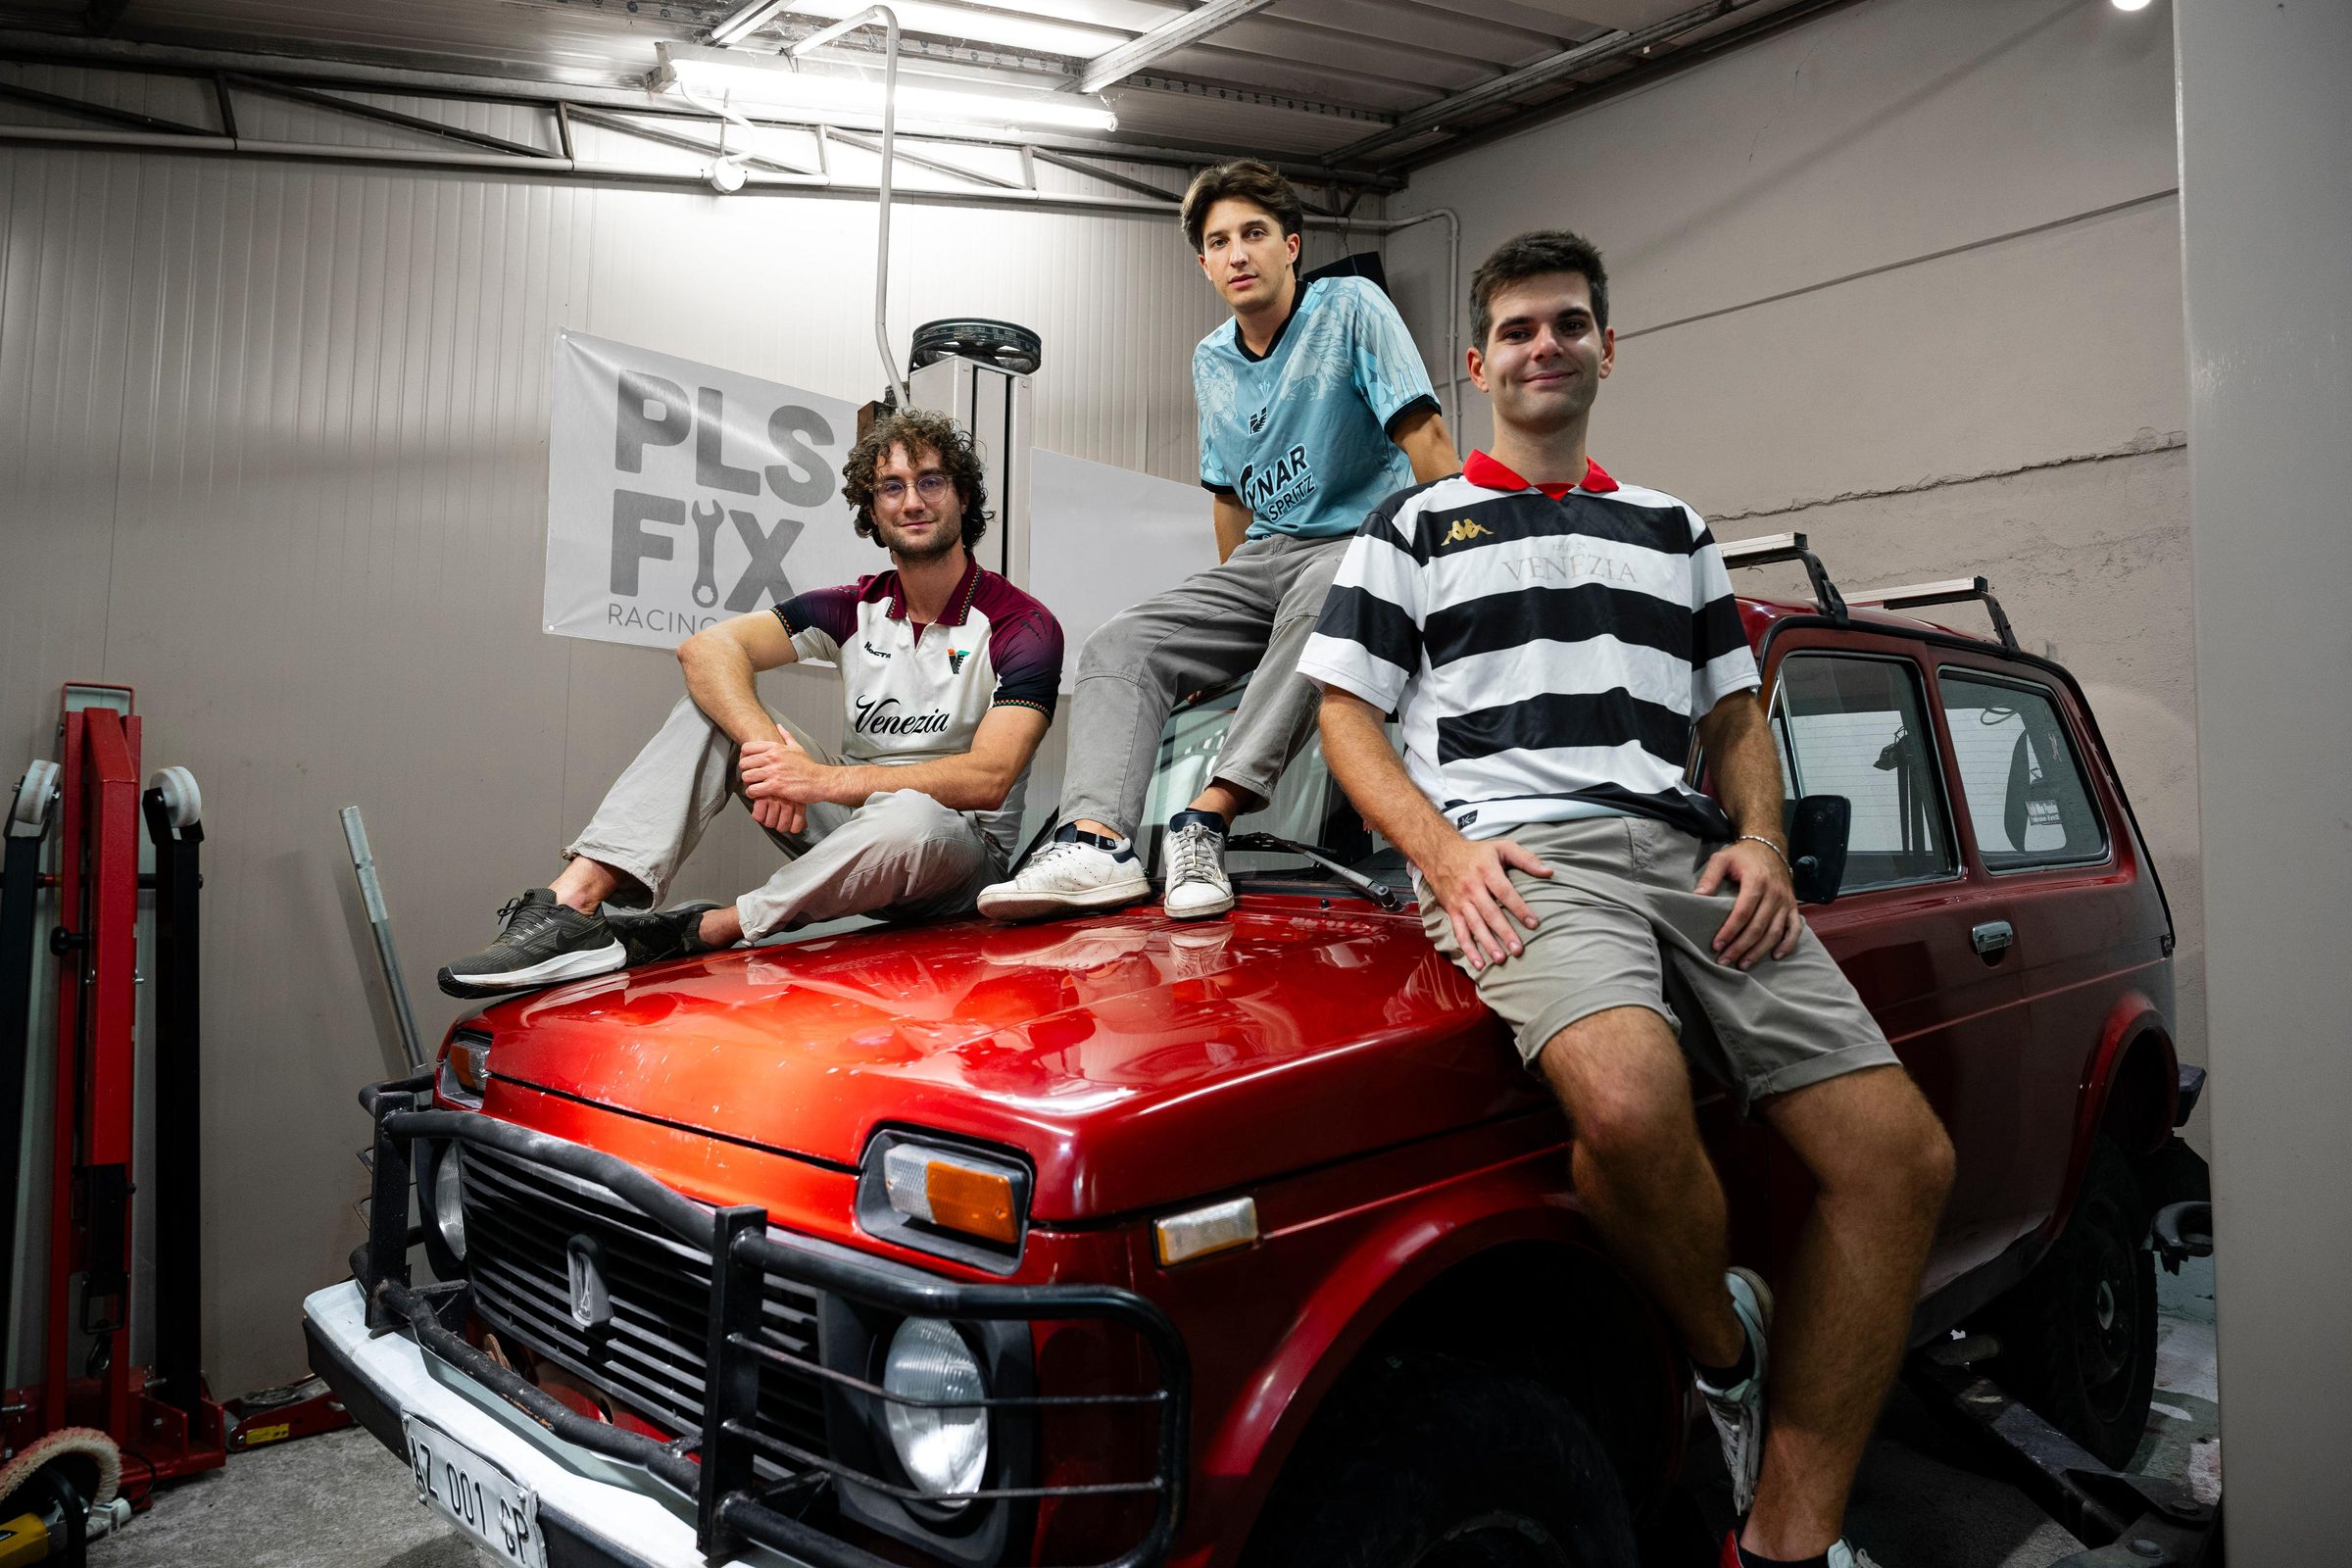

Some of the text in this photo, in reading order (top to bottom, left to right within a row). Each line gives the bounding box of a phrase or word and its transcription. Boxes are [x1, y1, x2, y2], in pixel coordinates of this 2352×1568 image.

[615, 369, 836, 508] PLS
[1268, 474, 1315, 520] SPRITZ
[1501, 555, 1639, 583] VENEZIA
[855, 694, 950, 735] Venezia
[411, 1436, 439, 1500] AZ
[447, 1461, 486, 1536] 001
